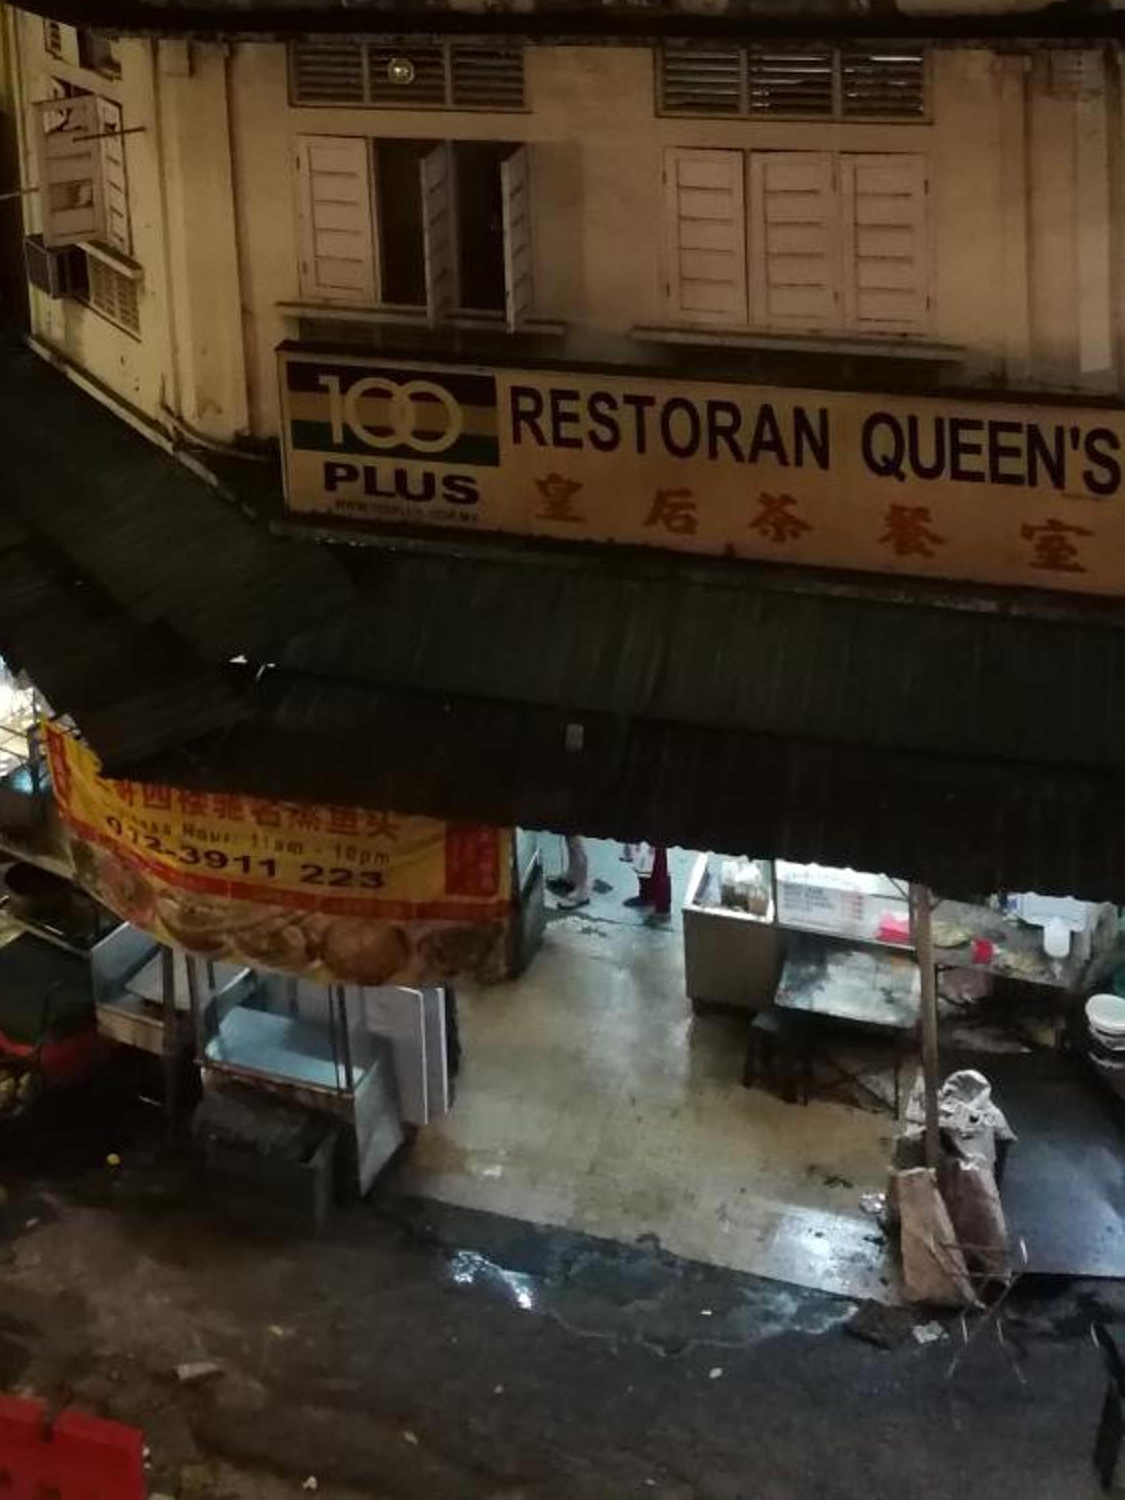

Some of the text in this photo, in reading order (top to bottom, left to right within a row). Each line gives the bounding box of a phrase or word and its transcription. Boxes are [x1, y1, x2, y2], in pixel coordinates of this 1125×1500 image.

[319, 375, 462, 453] 100
[510, 386, 1121, 495] RESTORAN QUEEN'S
[323, 461, 479, 505] PLUS
[299, 864, 386, 889] 223
